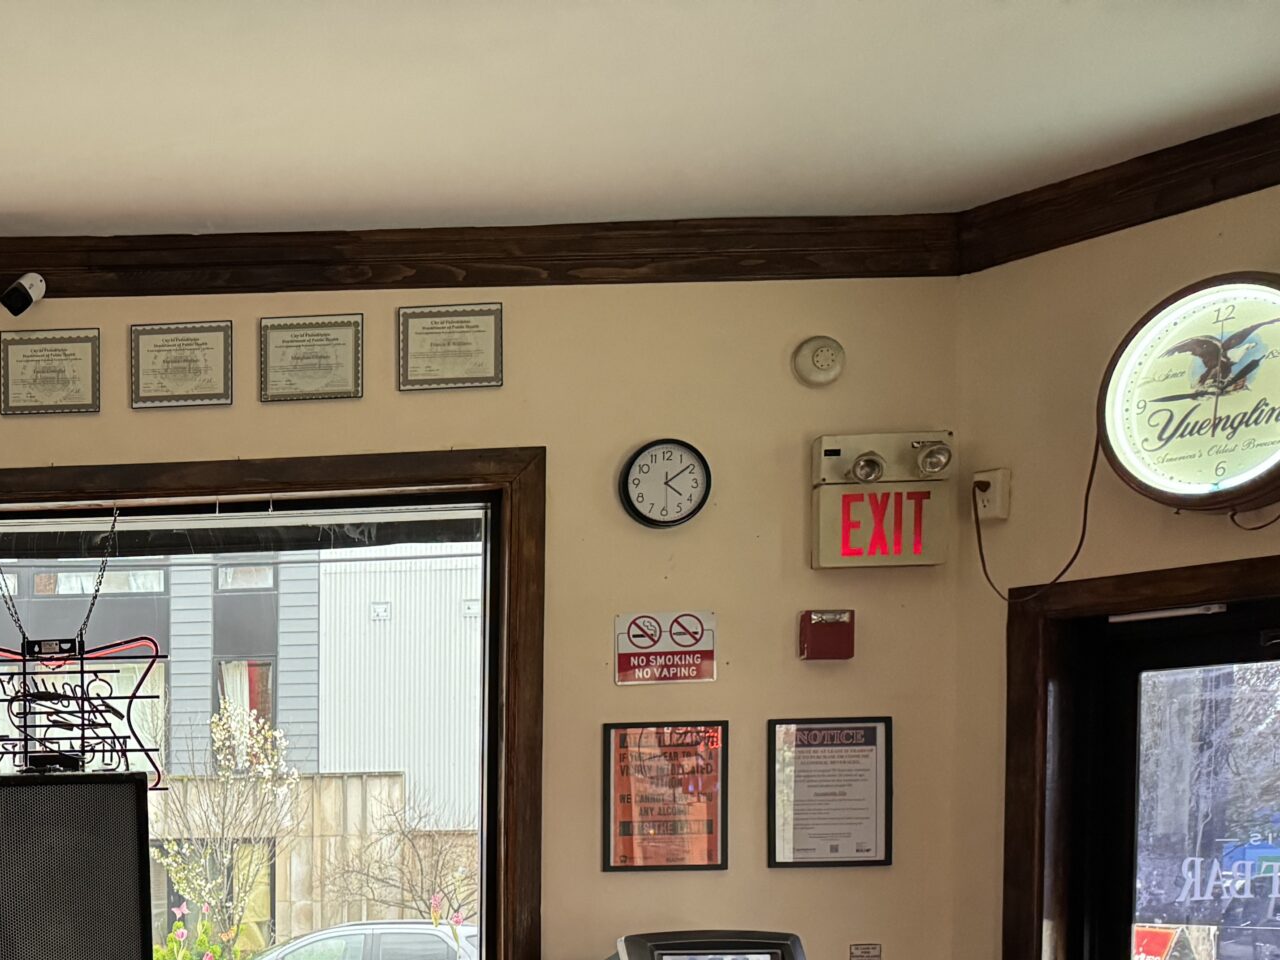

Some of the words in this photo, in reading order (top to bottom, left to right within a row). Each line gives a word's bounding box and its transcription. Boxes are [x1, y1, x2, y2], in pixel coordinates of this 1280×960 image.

[1212, 304, 1236, 324] 12
[1136, 400, 1147, 415] 9
[1141, 397, 1280, 452] Yuenglin
[1207, 441, 1238, 458] Oldest
[650, 454, 657, 464] 11
[662, 451, 673, 461] 12
[639, 464, 650, 474] 10
[689, 464, 695, 474] 2
[1214, 460, 1226, 477] 6
[632, 478, 640, 488] 9
[691, 478, 699, 488] 3
[636, 493, 644, 503] 8
[687, 494, 692, 504] 4
[648, 503, 655, 513] 7
[660, 506, 668, 516] 6
[676, 503, 682, 513] 5
[840, 490, 931, 557] EXIT
[630, 656, 646, 666] NO
[649, 654, 701, 666] SMOKING
[635, 668, 651, 679] NO
[654, 666, 697, 678] VAPING
[795, 729, 865, 744] NOTICE
